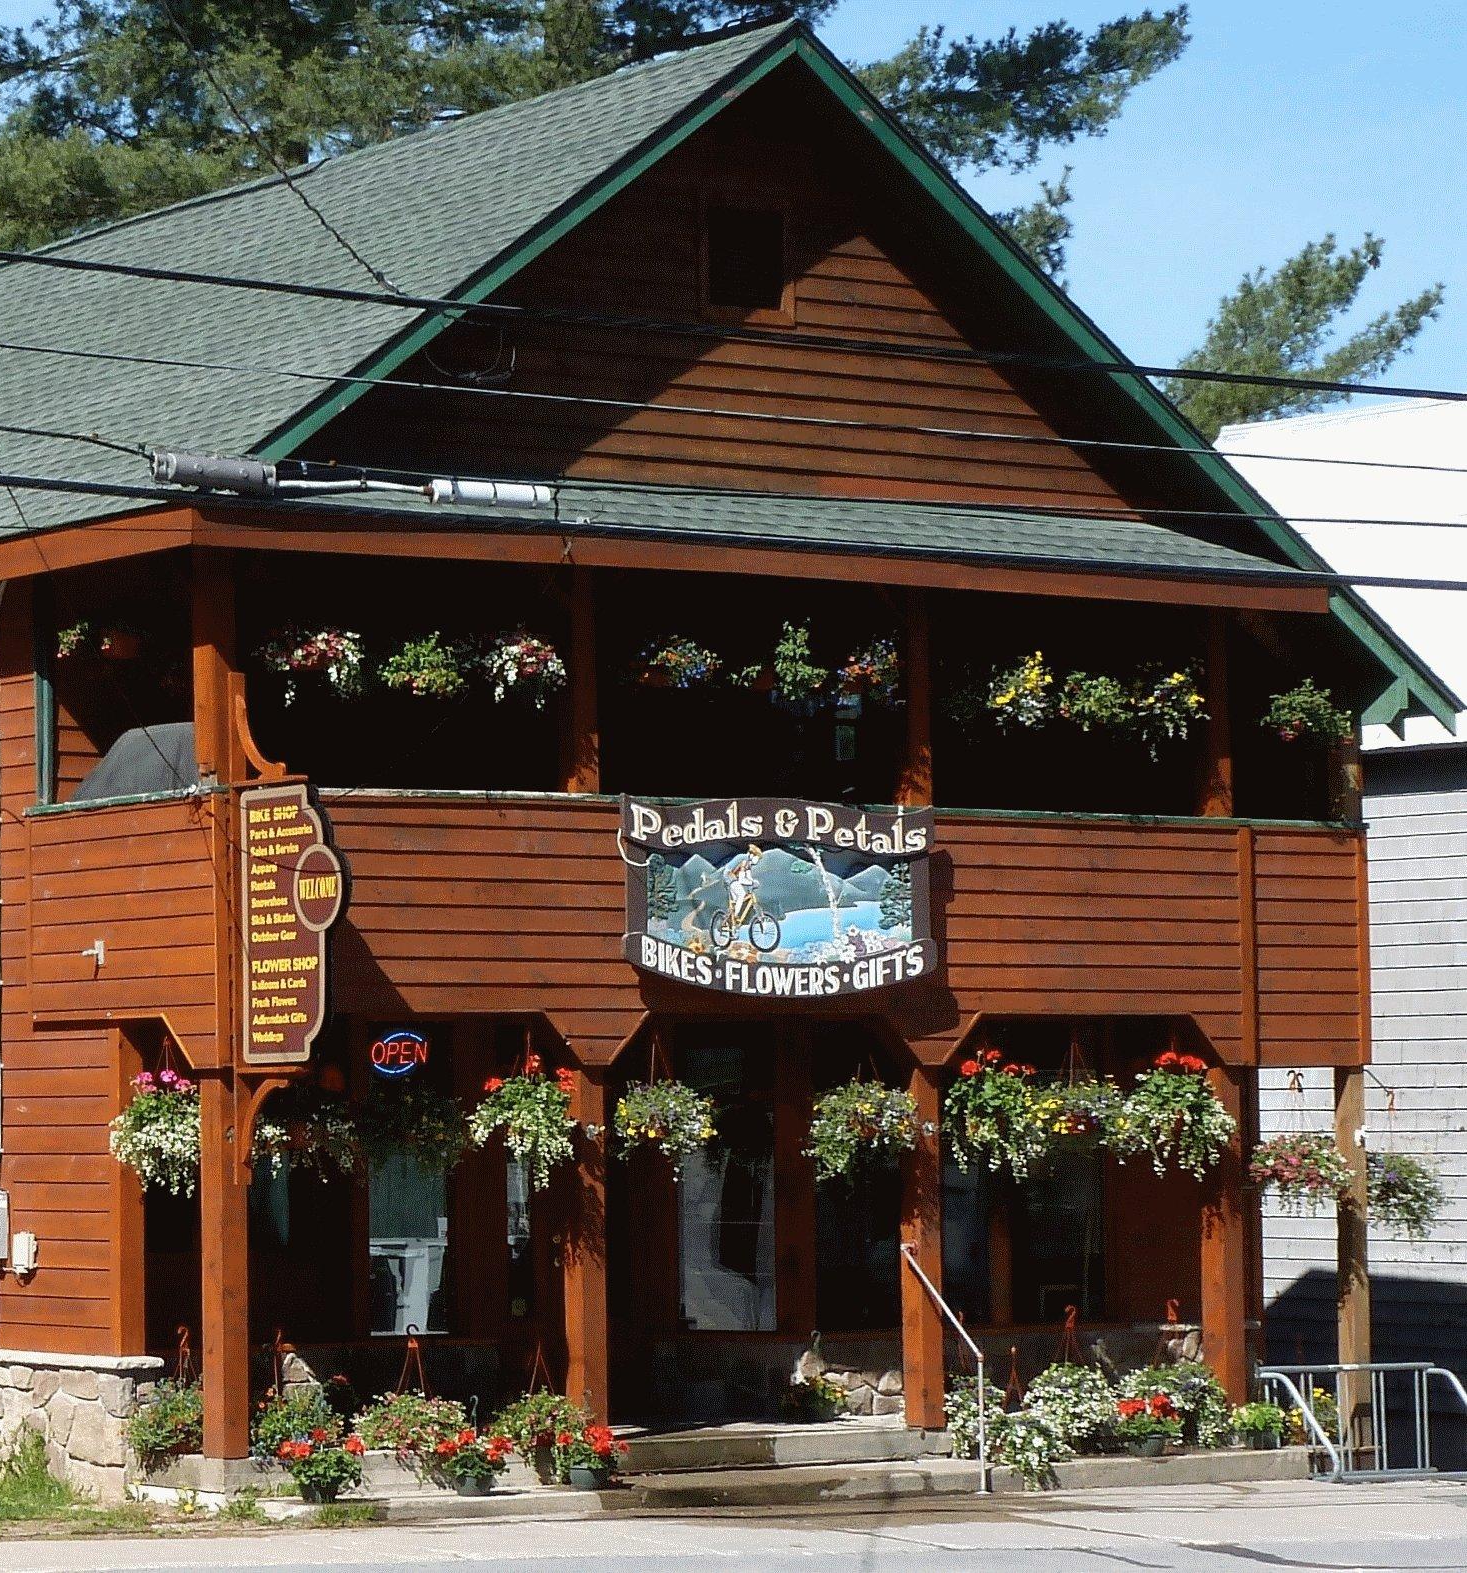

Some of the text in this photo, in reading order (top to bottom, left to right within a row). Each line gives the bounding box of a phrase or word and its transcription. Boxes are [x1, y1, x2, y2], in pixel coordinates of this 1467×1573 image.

[249, 806, 299, 823] BIKE SHOP
[250, 830, 268, 840] Parts
[269, 828, 275, 838] &
[630, 801, 927, 854] Pedals & Petals
[269, 845, 275, 855] &
[275, 843, 299, 854] Service
[299, 876, 337, 900] WELCOME
[266, 914, 272, 924] &
[251, 956, 318, 973] FLOWER SHOP
[640, 936, 924, 996] BIKES FLOWERS GIFTS
[280, 978, 286, 988] &
[271, 996, 297, 1007] Flowers
[371, 1041, 428, 1064] OPEN
